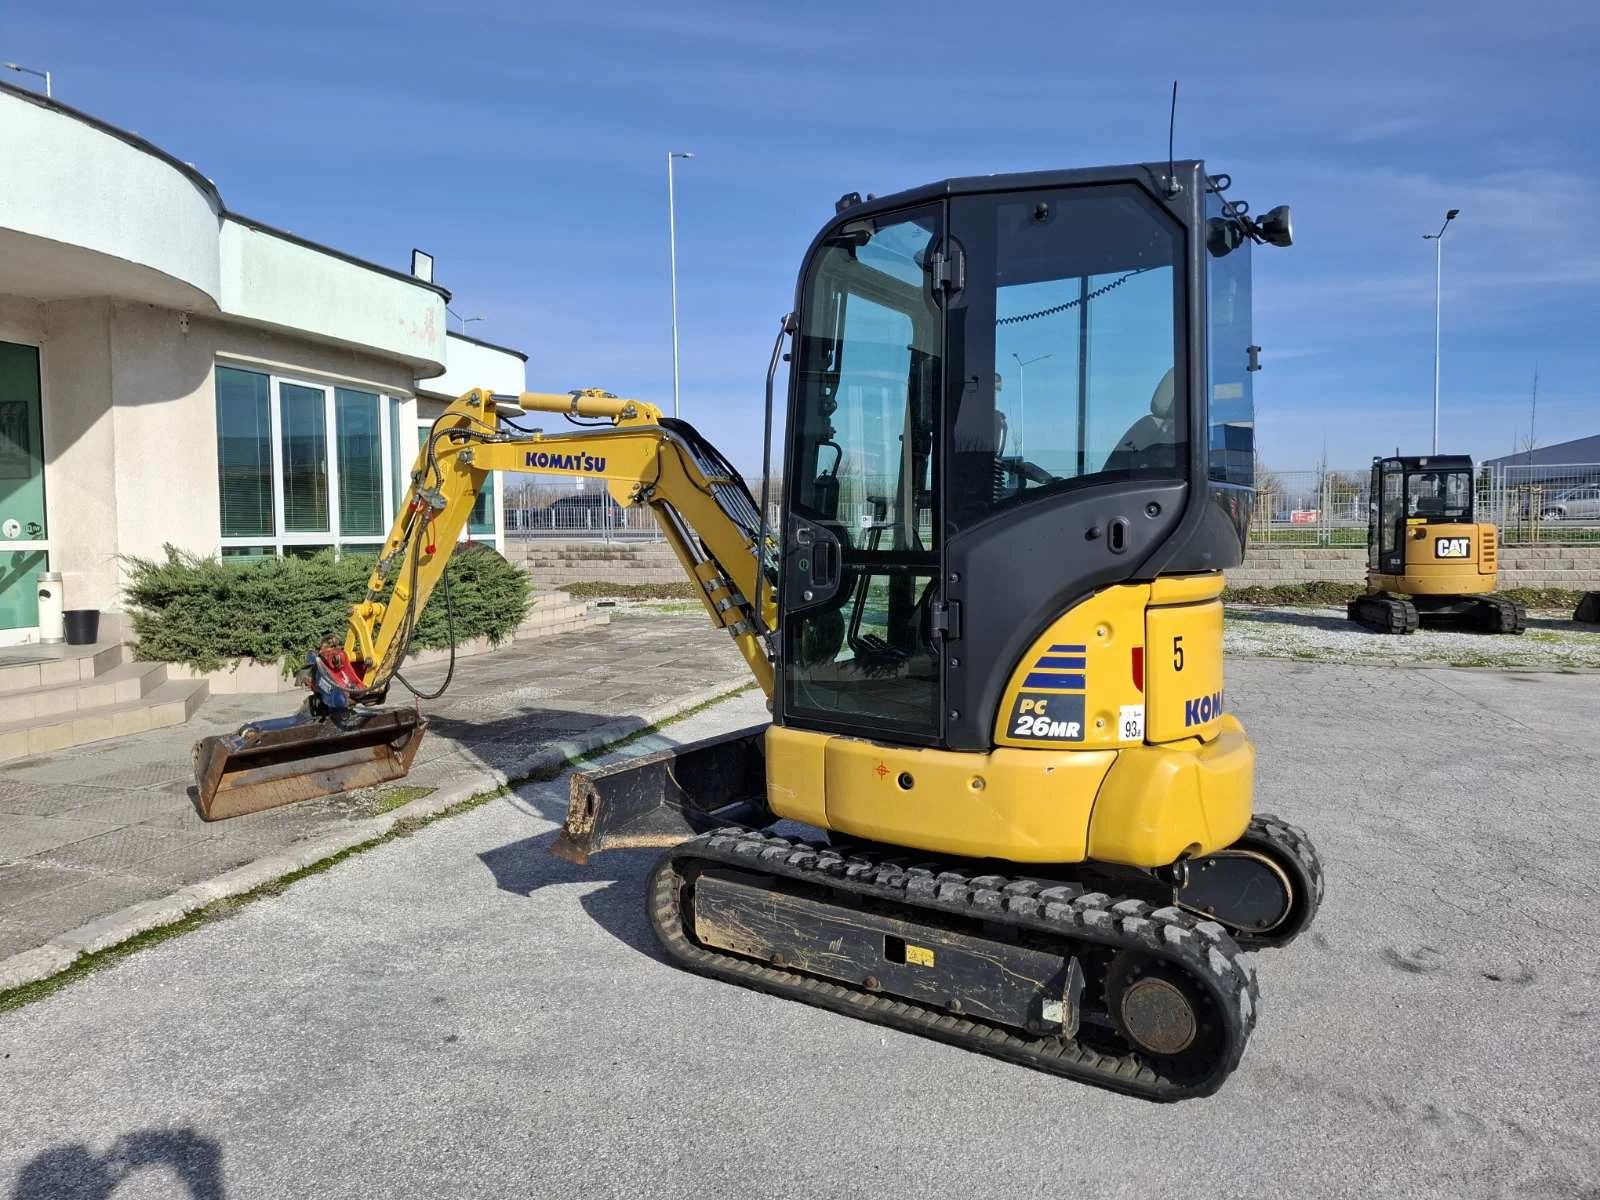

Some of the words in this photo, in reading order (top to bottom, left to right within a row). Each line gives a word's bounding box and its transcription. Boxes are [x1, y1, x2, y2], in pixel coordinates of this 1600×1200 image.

[525, 451, 606, 473] KOMATSU
[1437, 539, 1469, 557] CAT
[1173, 636, 1184, 672] 5
[1019, 698, 1048, 715] PC
[1185, 688, 1224, 727] KOM
[1014, 715, 1081, 738] 26MR
[1125, 720, 1137, 738] 93
